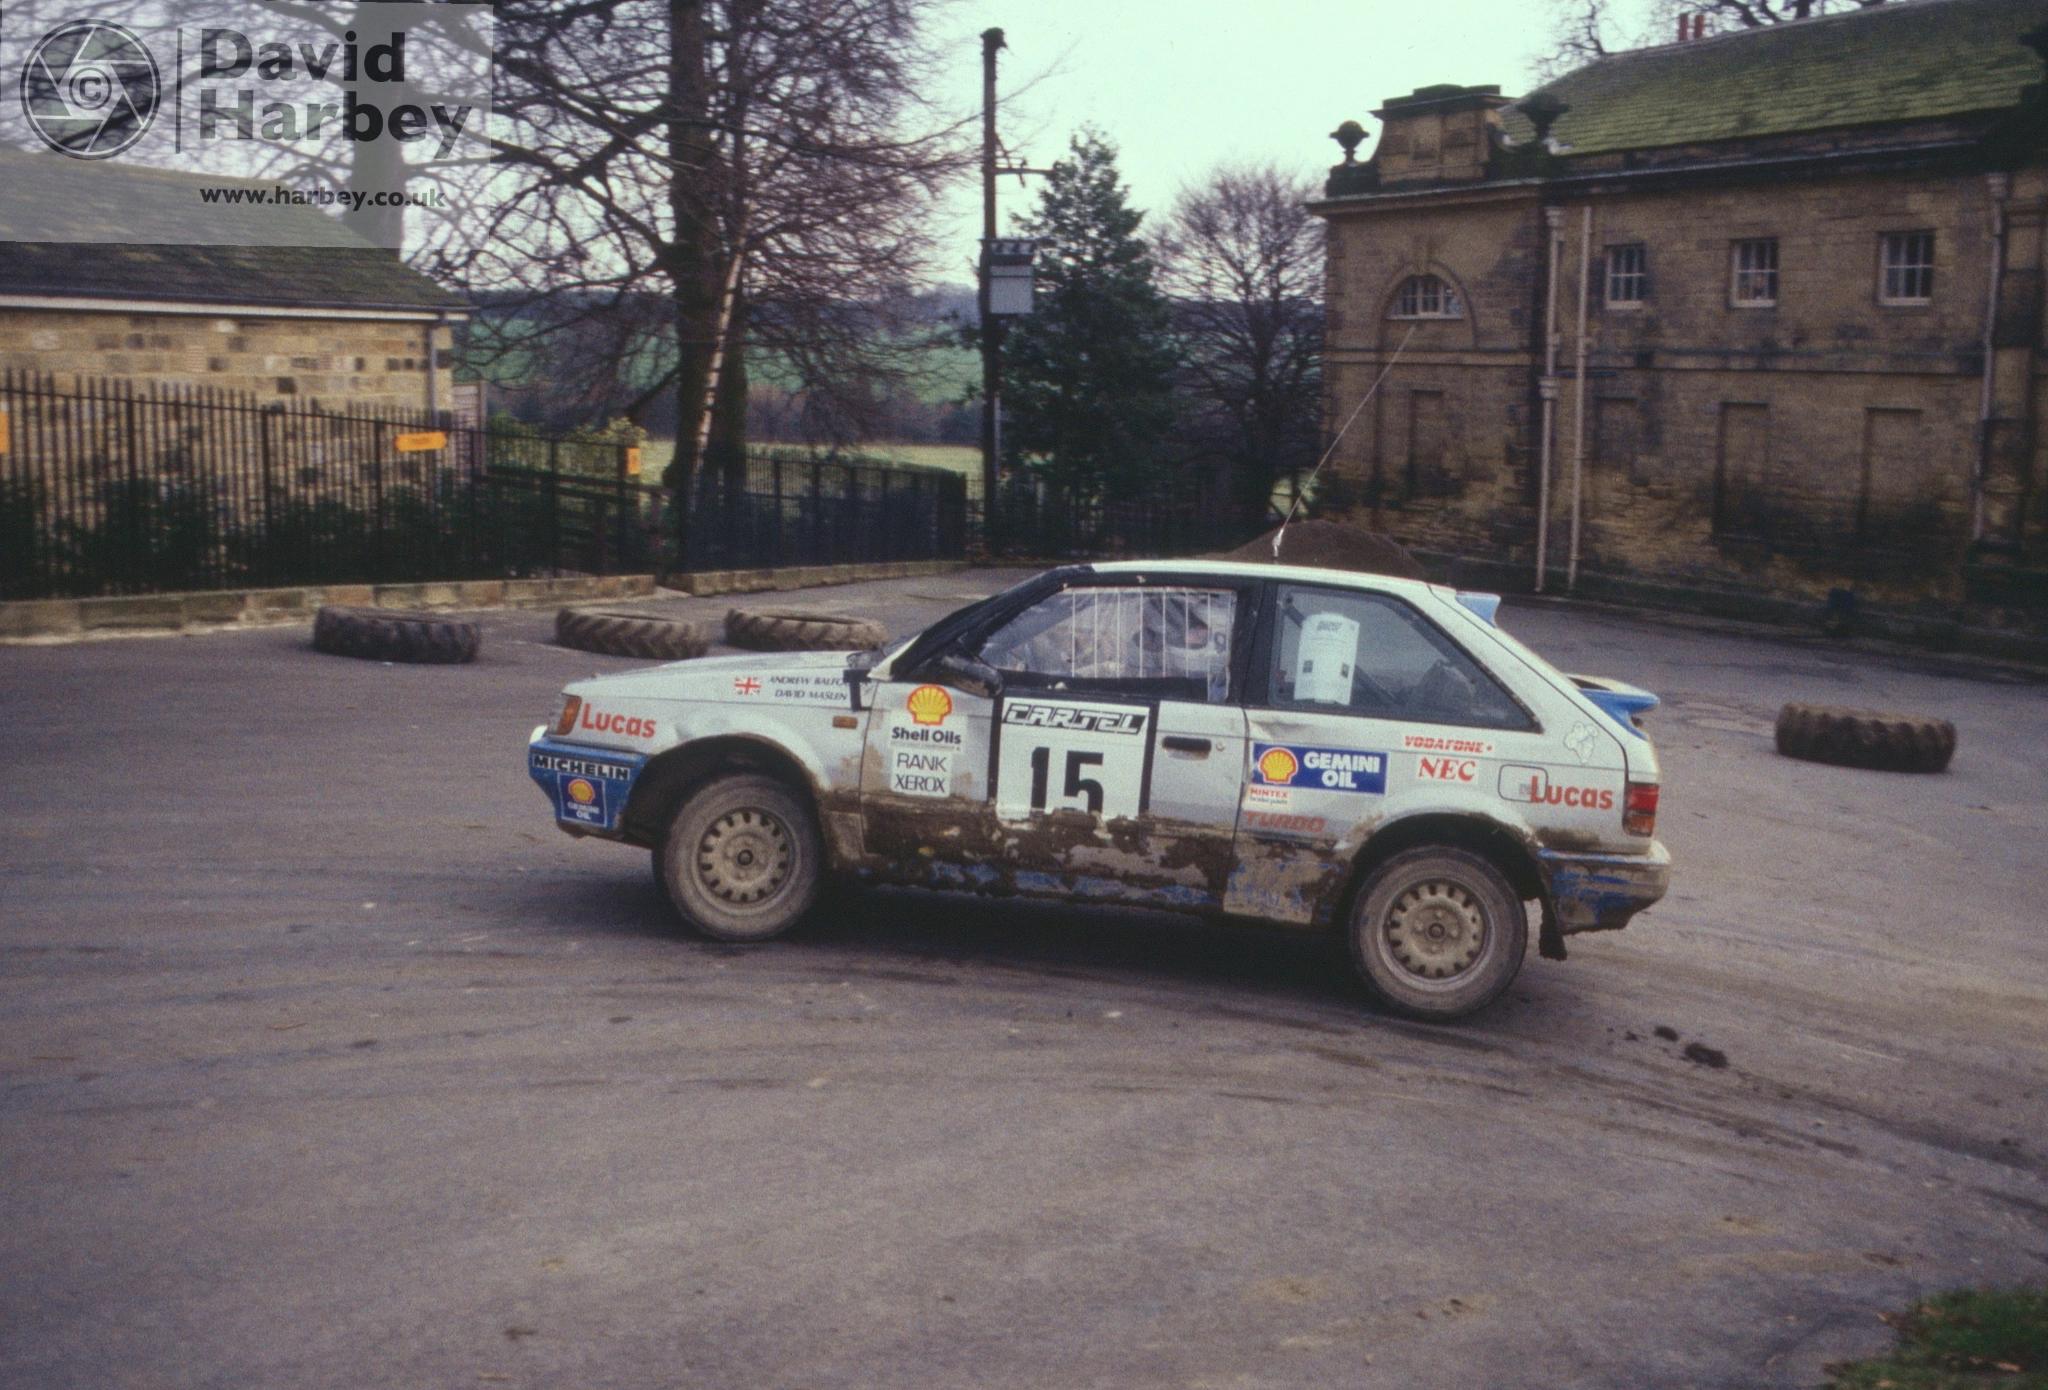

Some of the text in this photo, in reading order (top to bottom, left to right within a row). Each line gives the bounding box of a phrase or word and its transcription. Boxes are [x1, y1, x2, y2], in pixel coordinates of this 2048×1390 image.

[775, 689, 848, 700] DAVID MASLEN
[581, 703, 656, 739] Lucas
[1002, 703, 1146, 735] CARTEL
[891, 726, 962, 744] Shell Oils
[1405, 735, 1484, 754] VODAFONE
[533, 756, 630, 780] MICHELIN
[896, 752, 947, 773] RANK
[1304, 751, 1380, 773] GEMINI
[1418, 757, 1476, 783] NEC
[894, 773, 946, 794] XEROX
[1031, 746, 1104, 814] 15
[1321, 769, 1357, 789] OIL
[1250, 788, 1288, 799] MINTEX
[1530, 775, 1614, 811] Lucas
